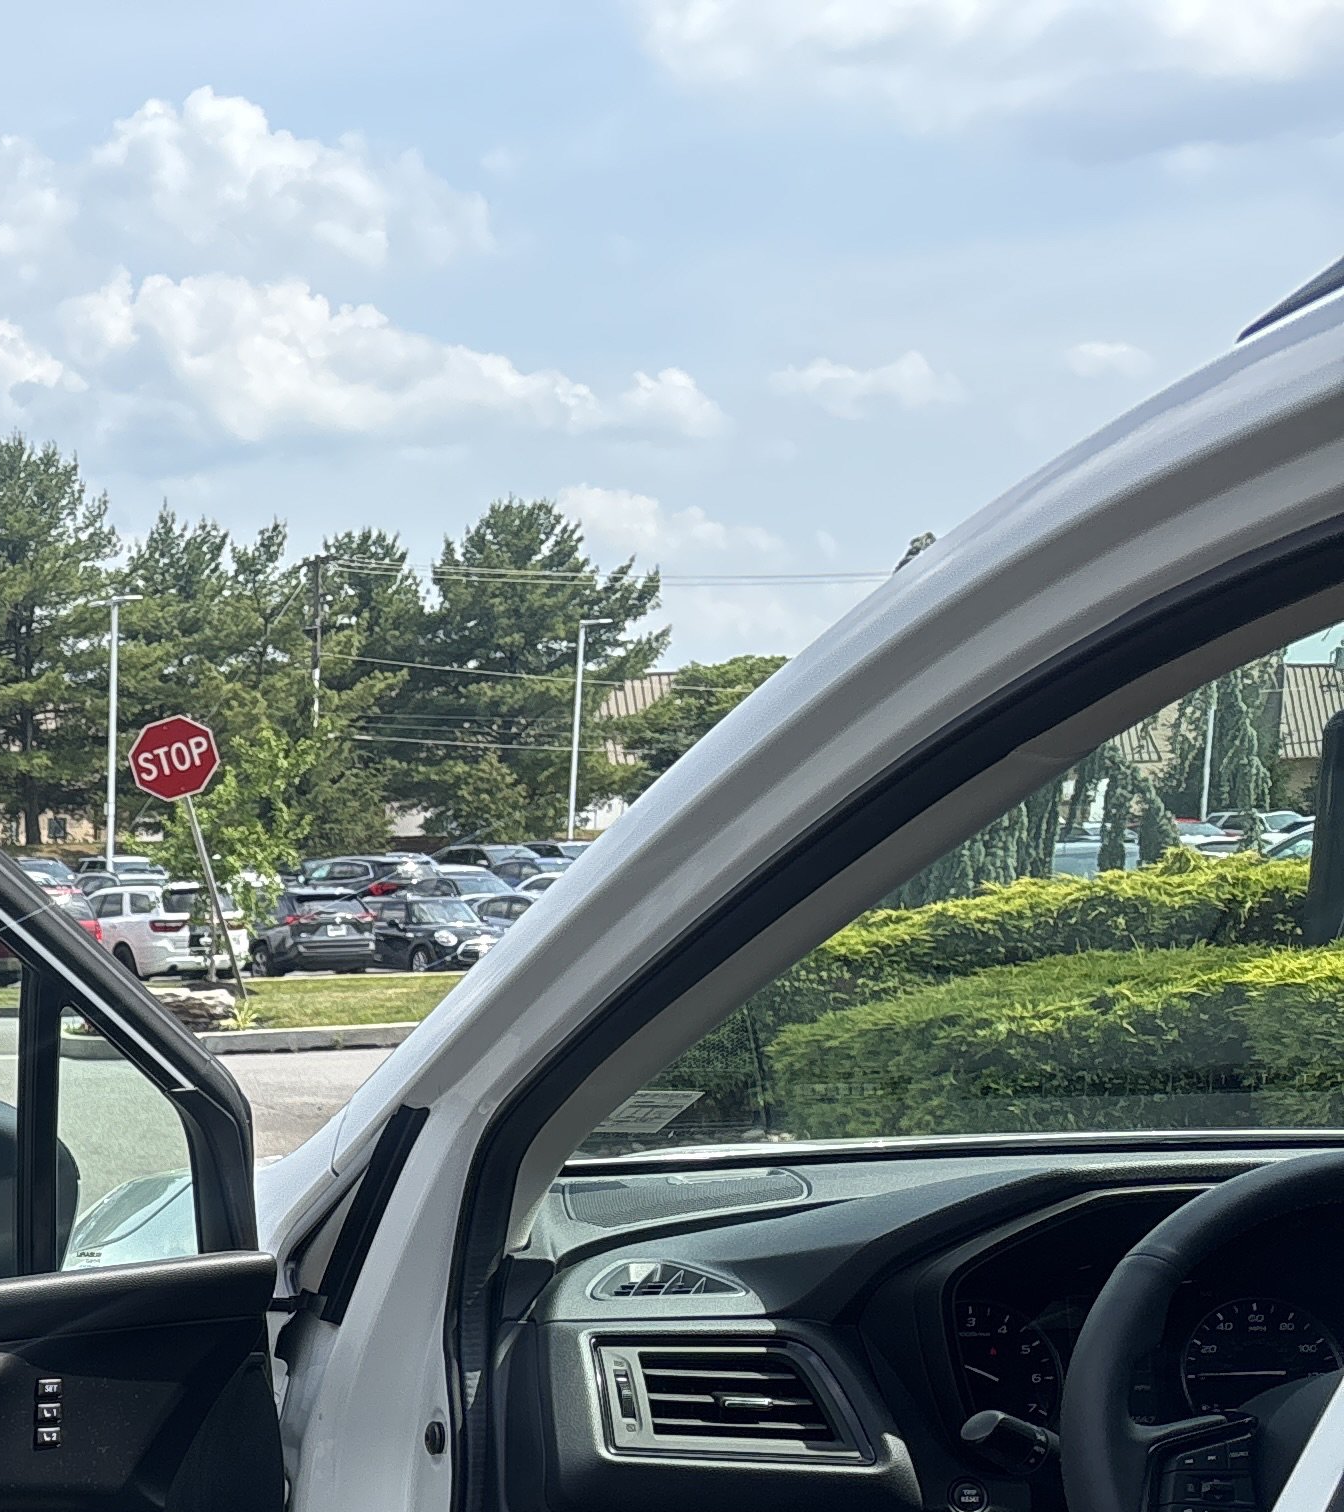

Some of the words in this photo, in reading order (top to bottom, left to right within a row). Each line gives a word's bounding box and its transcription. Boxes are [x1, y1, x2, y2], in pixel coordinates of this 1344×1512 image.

[138, 736, 208, 781] STOP
[965, 1317, 977, 1327] 3
[1216, 1322, 1233, 1331] 40
[1020, 1344, 1031, 1354] 5
[1031, 1374, 1042, 1383] 6
[1027, 1403, 1037, 1413] 7
